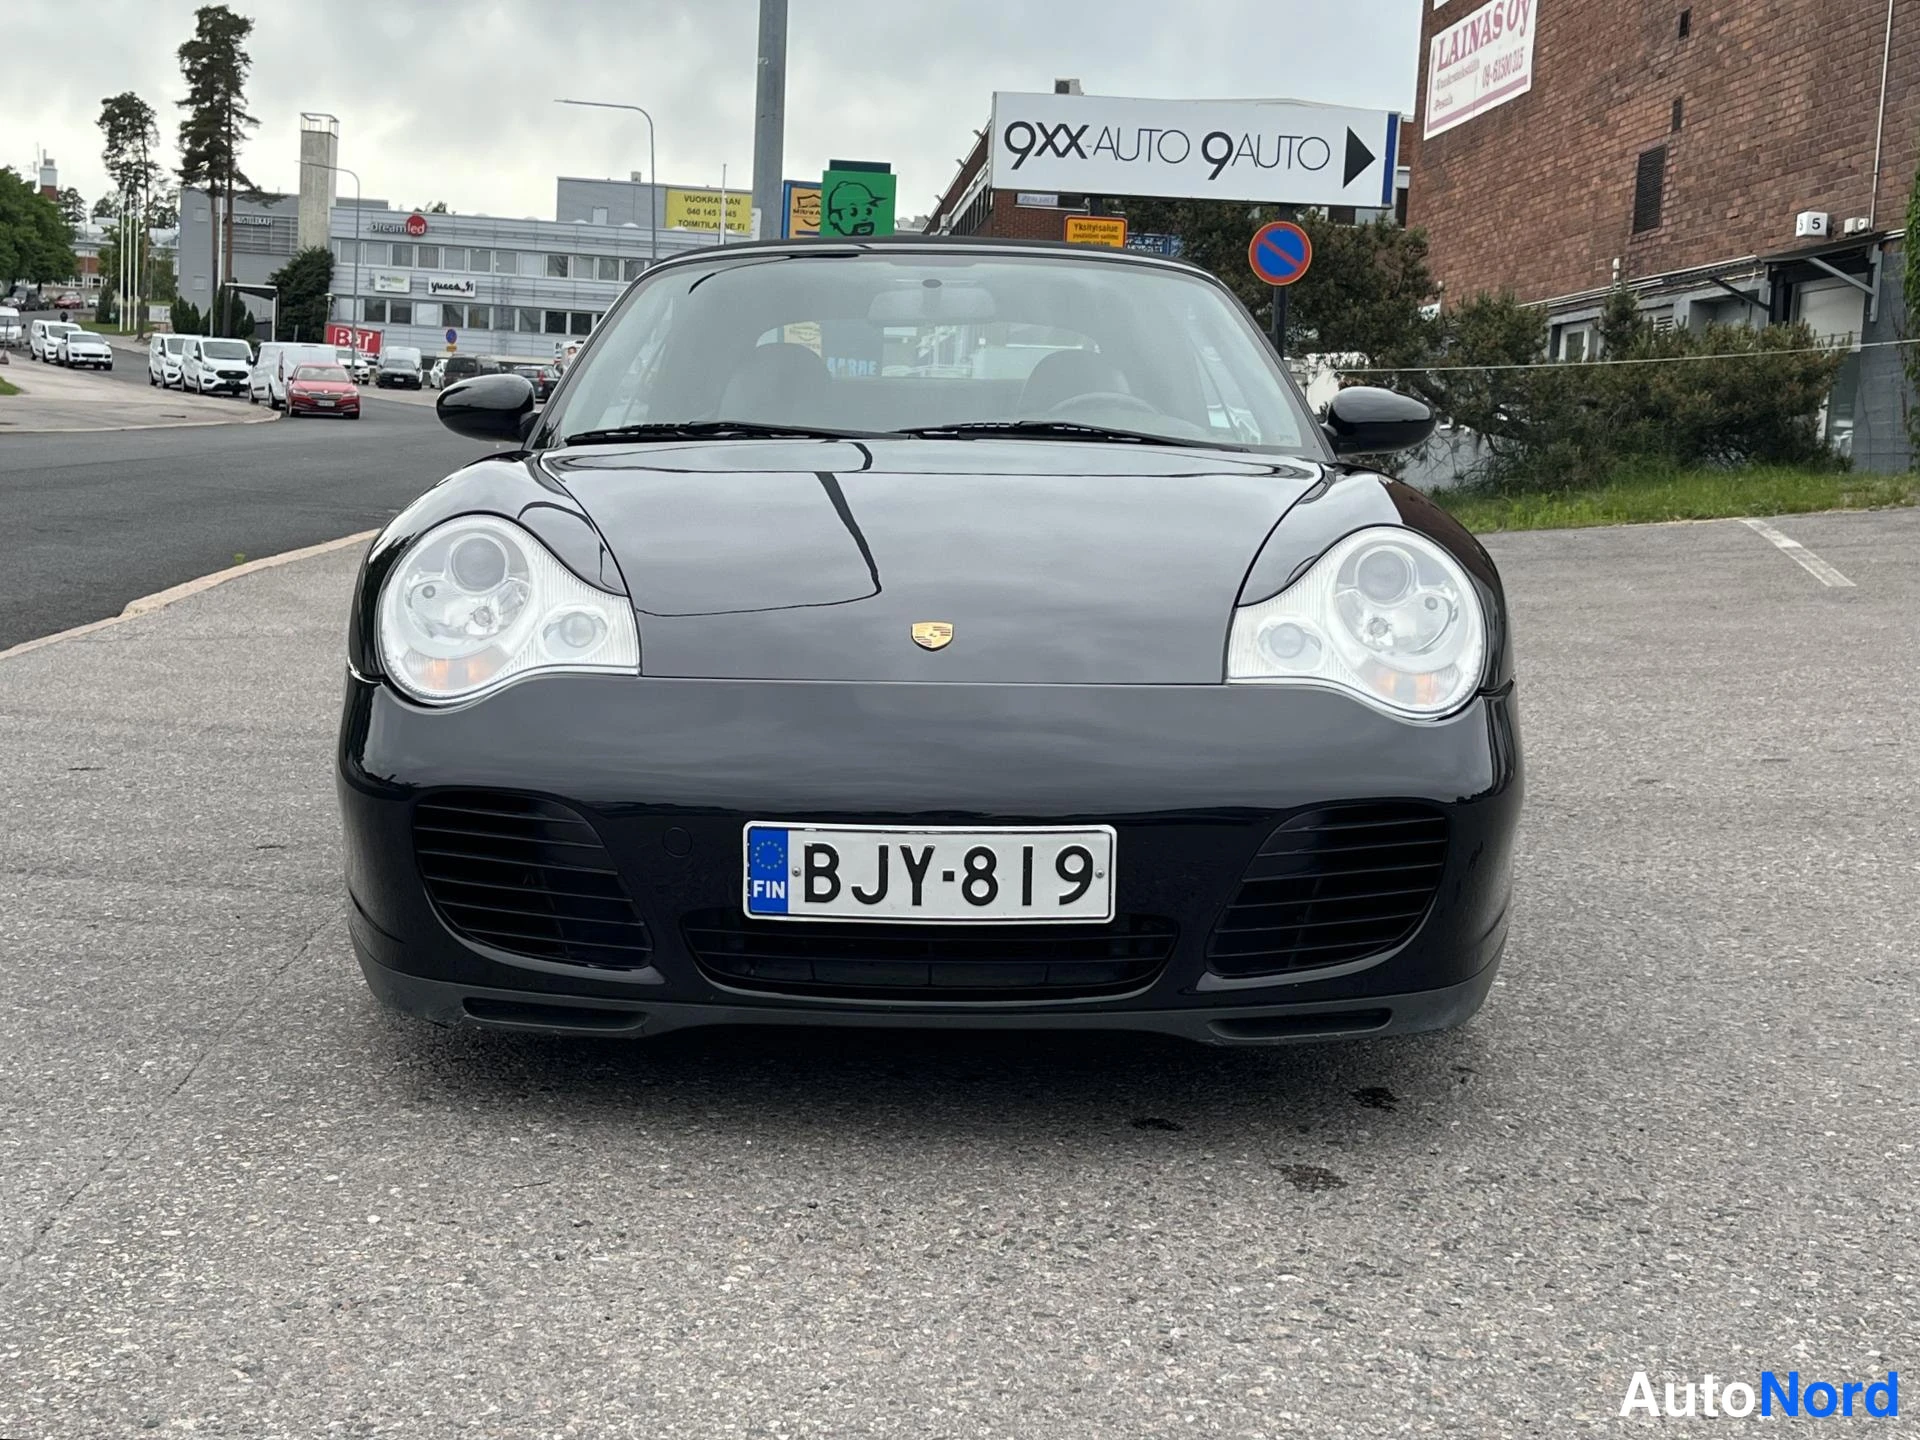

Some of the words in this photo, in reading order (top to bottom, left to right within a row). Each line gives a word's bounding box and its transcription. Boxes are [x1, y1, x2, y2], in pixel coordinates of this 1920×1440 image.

[1438, 1, 1504, 72] LAINAS
[1004, 121, 1190, 170] 9XX-AUTO
[1201, 131, 1330, 180] 9AUTO
[371, 221, 425, 234] dreamled
[1811, 217, 1821, 230] 5
[753, 880, 785, 899] FIN
[804, 842, 1093, 906] BJY-819
